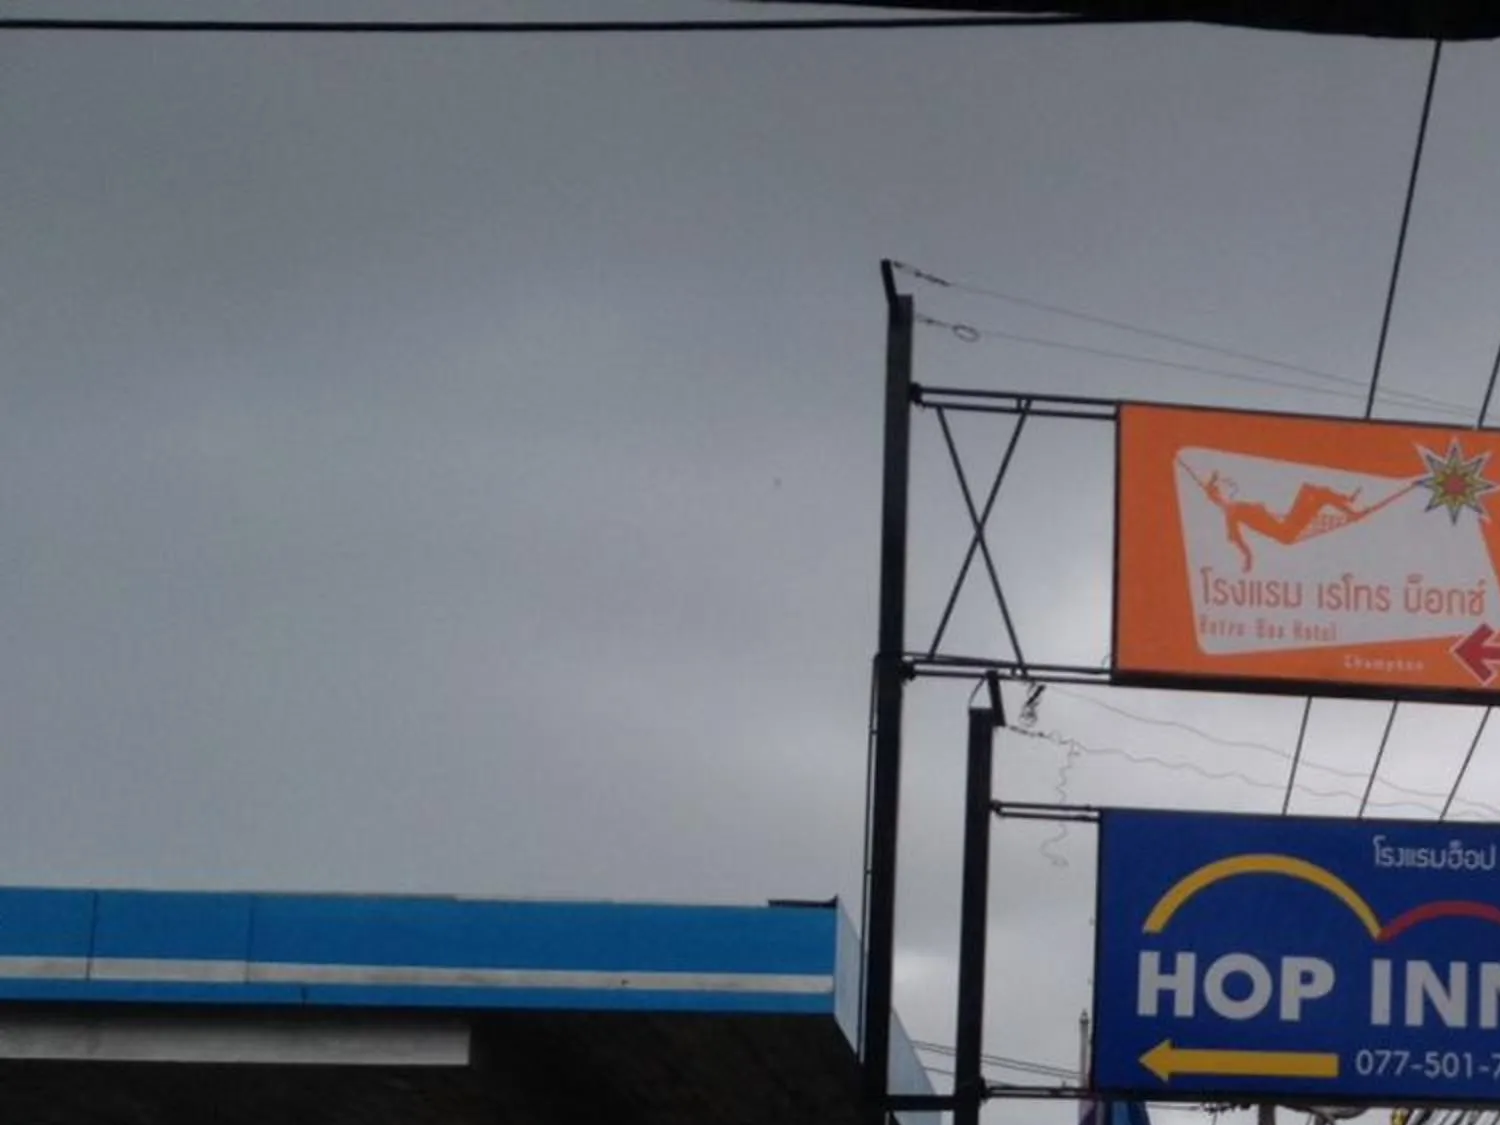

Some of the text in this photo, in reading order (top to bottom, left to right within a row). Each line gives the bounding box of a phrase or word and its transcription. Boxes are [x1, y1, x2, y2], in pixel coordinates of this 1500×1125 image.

[1200, 567, 1303, 608] โรงแรม
[1317, 573, 1391, 612] เรโทร
[1137, 951, 1336, 1021] HOP
